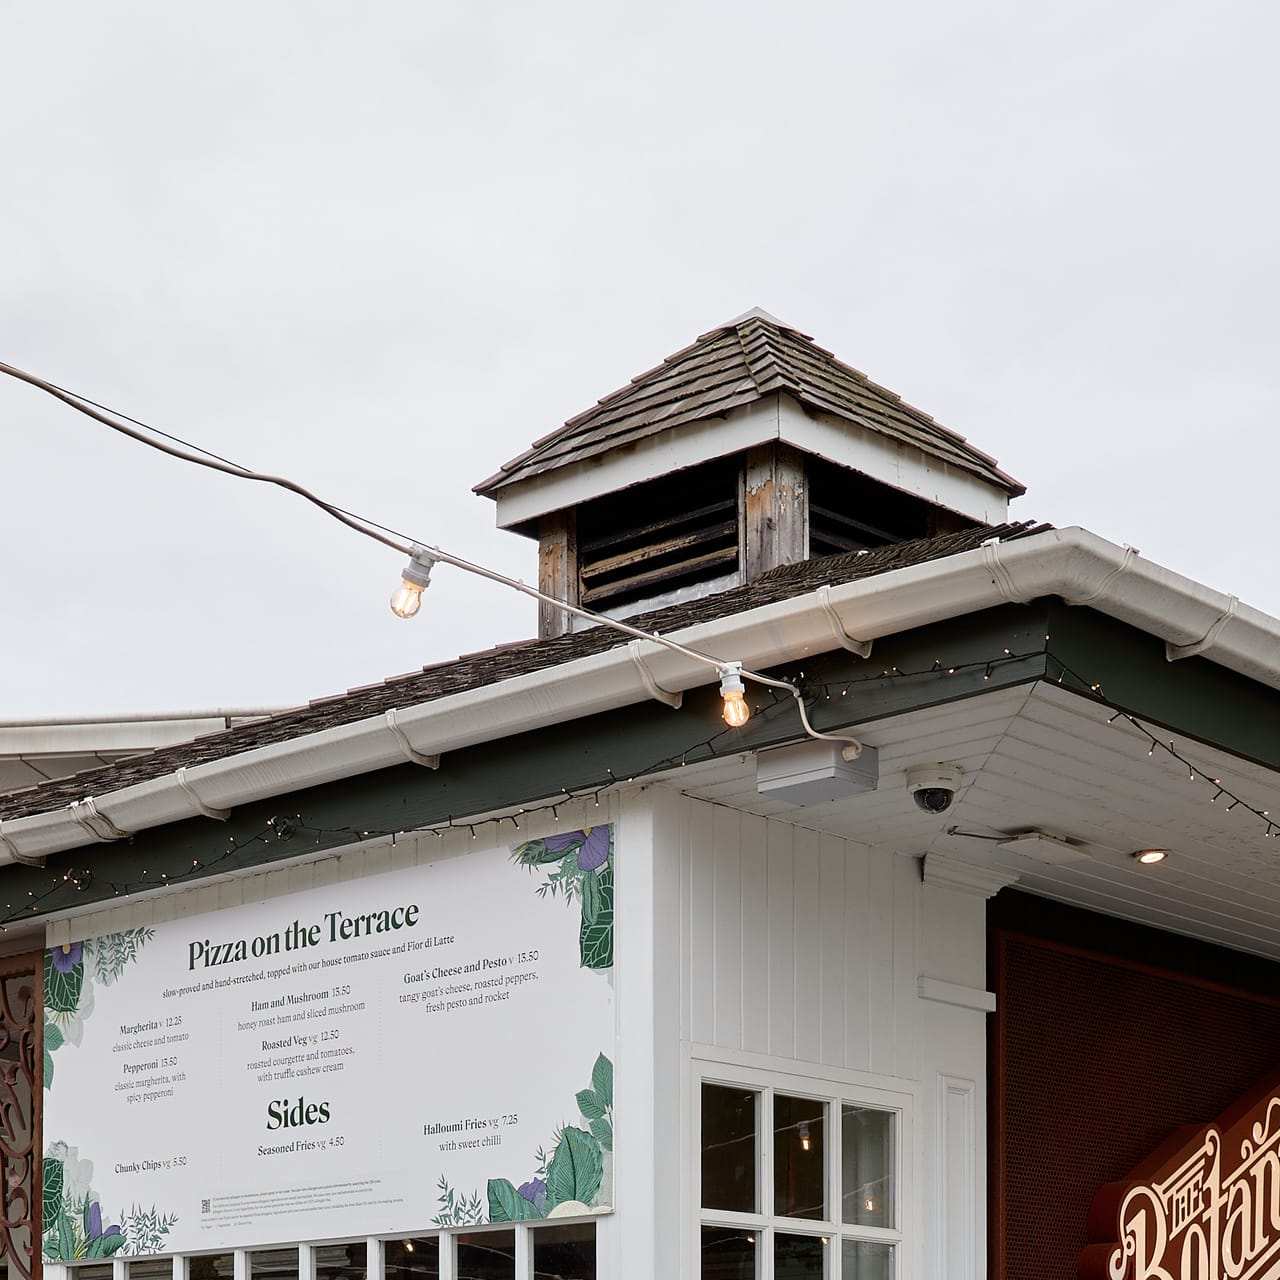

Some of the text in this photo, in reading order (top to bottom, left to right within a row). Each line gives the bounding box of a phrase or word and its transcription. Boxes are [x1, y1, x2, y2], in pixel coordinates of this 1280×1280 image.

[188, 904, 419, 971] Pizza on the Terrace
[162, 934, 455, 998] slow-proved and hand-stretched, topped with our house tomato sauce and Fior di Latte
[432, 965, 462, 979] Cheese
[464, 960, 481, 973] and
[482, 956, 507, 970] Pesto
[399, 992, 421, 1004] tangy
[445, 982, 473, 995] cheese,
[474, 975, 504, 989] roasted
[505, 971, 539, 986] peppers,
[251, 1001, 269, 1012] Ham
[270, 996, 285, 1008] and
[286, 990, 329, 1005] Mushroom
[426, 990, 510, 1013] fresh pesto and rocket
[237, 1001, 366, 1031] honey roast ham and sliced mushroom
[119, 1020, 158, 1036] Margherita
[112, 1032, 189, 1053] classic cheese and tomato
[261, 1029, 340, 1051] Roasted Veg vg 12.50
[123, 1058, 159, 1074] Pepperoni
[247, 1045, 355, 1071] roasted courgette and tomatoes,
[114, 1079, 135, 1091] classic
[171, 1071, 187, 1082] with
[257, 1061, 344, 1083] with truffle cashew cream
[126, 1086, 174, 1105] spicy pepperoni
[266, 1096, 331, 1131] Sides
[423, 1114, 518, 1136] Halloumi Fries vg 7.25
[257, 1135, 345, 1157] Seasoned Fries vg 4.50
[439, 1134, 501, 1152] with sweet chilli
[114, 1161, 141, 1174] Chunky
[141, 1158, 162, 1172] Chips
[1165, 1168, 1205, 1231] THE
